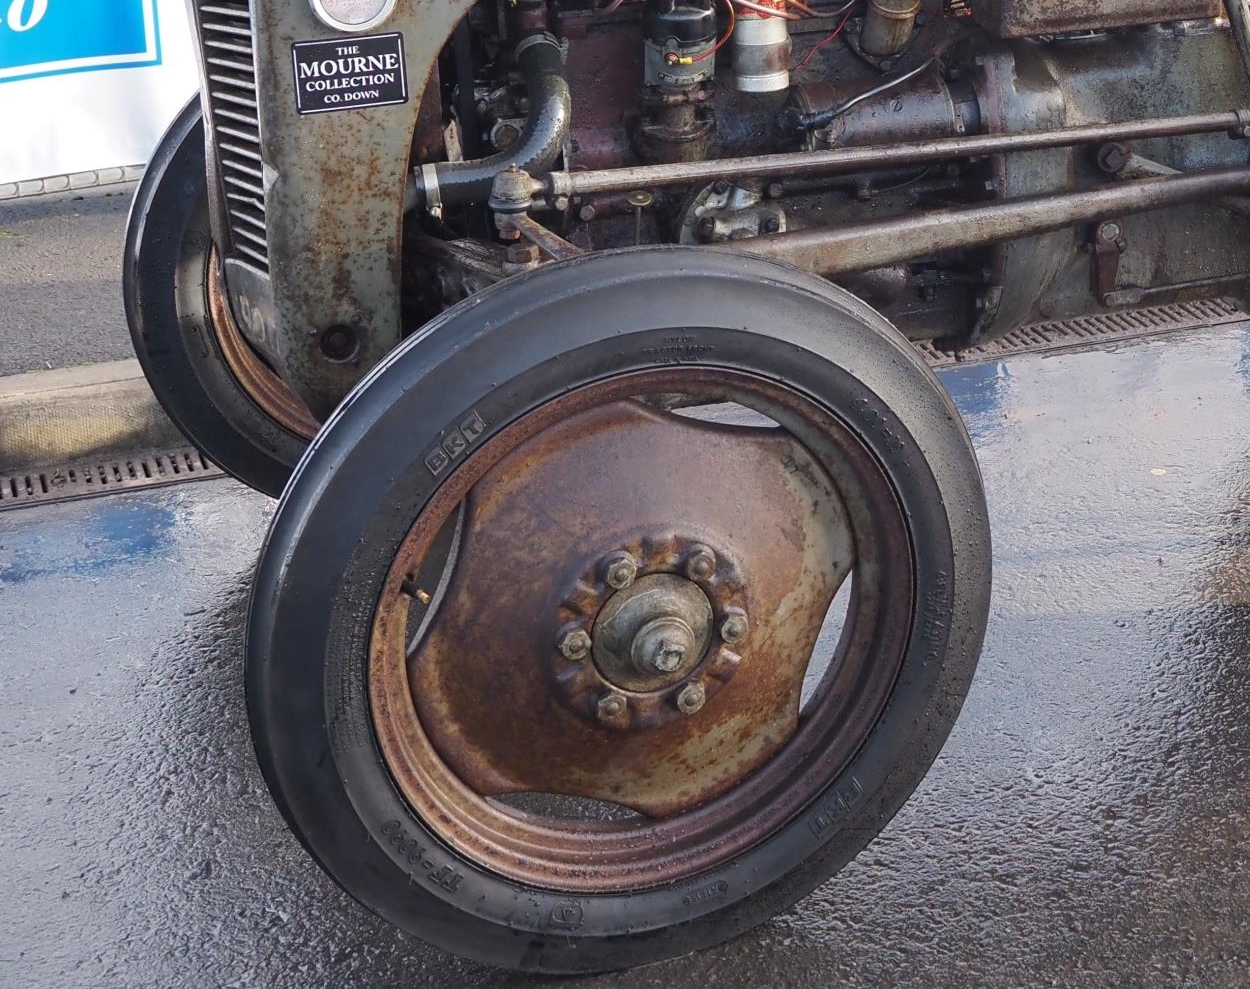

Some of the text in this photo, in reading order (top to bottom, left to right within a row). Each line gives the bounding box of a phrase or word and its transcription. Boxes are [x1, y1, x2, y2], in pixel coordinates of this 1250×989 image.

[336, 45, 360, 56] THE
[299, 53, 398, 79] MOURNE
[306, 73, 395, 92] COLLECTION
[324, 90, 380, 103] CO. DOWN
[425, 415, 484, 474] BKT
